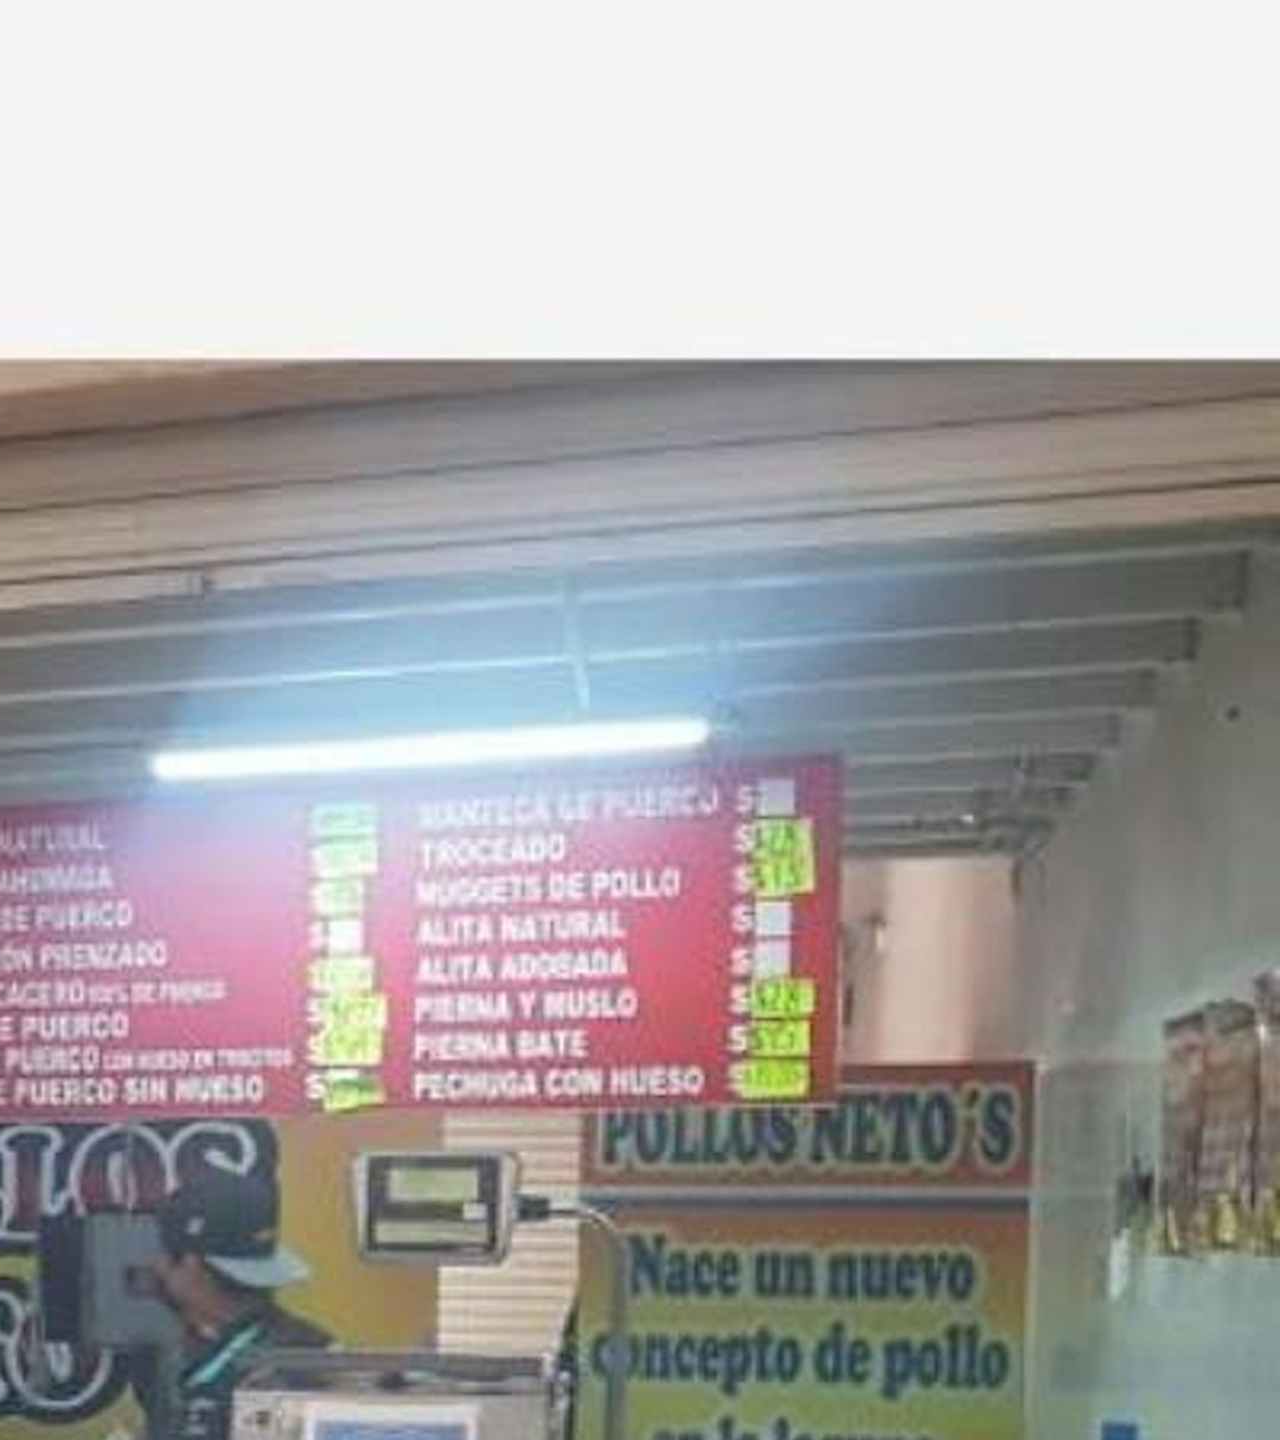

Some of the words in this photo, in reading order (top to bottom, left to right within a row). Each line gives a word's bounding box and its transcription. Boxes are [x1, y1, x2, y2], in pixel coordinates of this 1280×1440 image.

[417, 871, 544, 904] NUGGETS
[548, 871, 587, 899] DE
[592, 867, 681, 899] POLLO
[418, 913, 492, 945] ALITA
[502, 909, 627, 941] NATURAL
[417, 954, 492, 985] ALITA
[414, 993, 511, 1023] PIERNA
[518, 992, 536, 1018] Y
[543, 989, 639, 1019] MUSLO
[21, 1012, 129, 1040] PUERCO
[5, 1046, 100, 1072] PUERCO
[414, 1032, 509, 1060] PIERNA
[515, 1030, 589, 1058] BATE
[13, 1078, 117, 1106] PUERCO
[123, 1076, 167, 1103] SIN
[414, 1070, 537, 1100] PECHUGA
[545, 1068, 604, 1097] CON
[609, 1066, 705, 1096] HUESO
[602, 1109, 798, 1166] POLLOS
[627, 1233, 739, 1298] Nace
[754, 1250, 816, 1298] un
[828, 1248, 975, 1299] nuevo
[813, 1323, 872, 1383] de
[883, 1324, 1010, 1398] pollo
